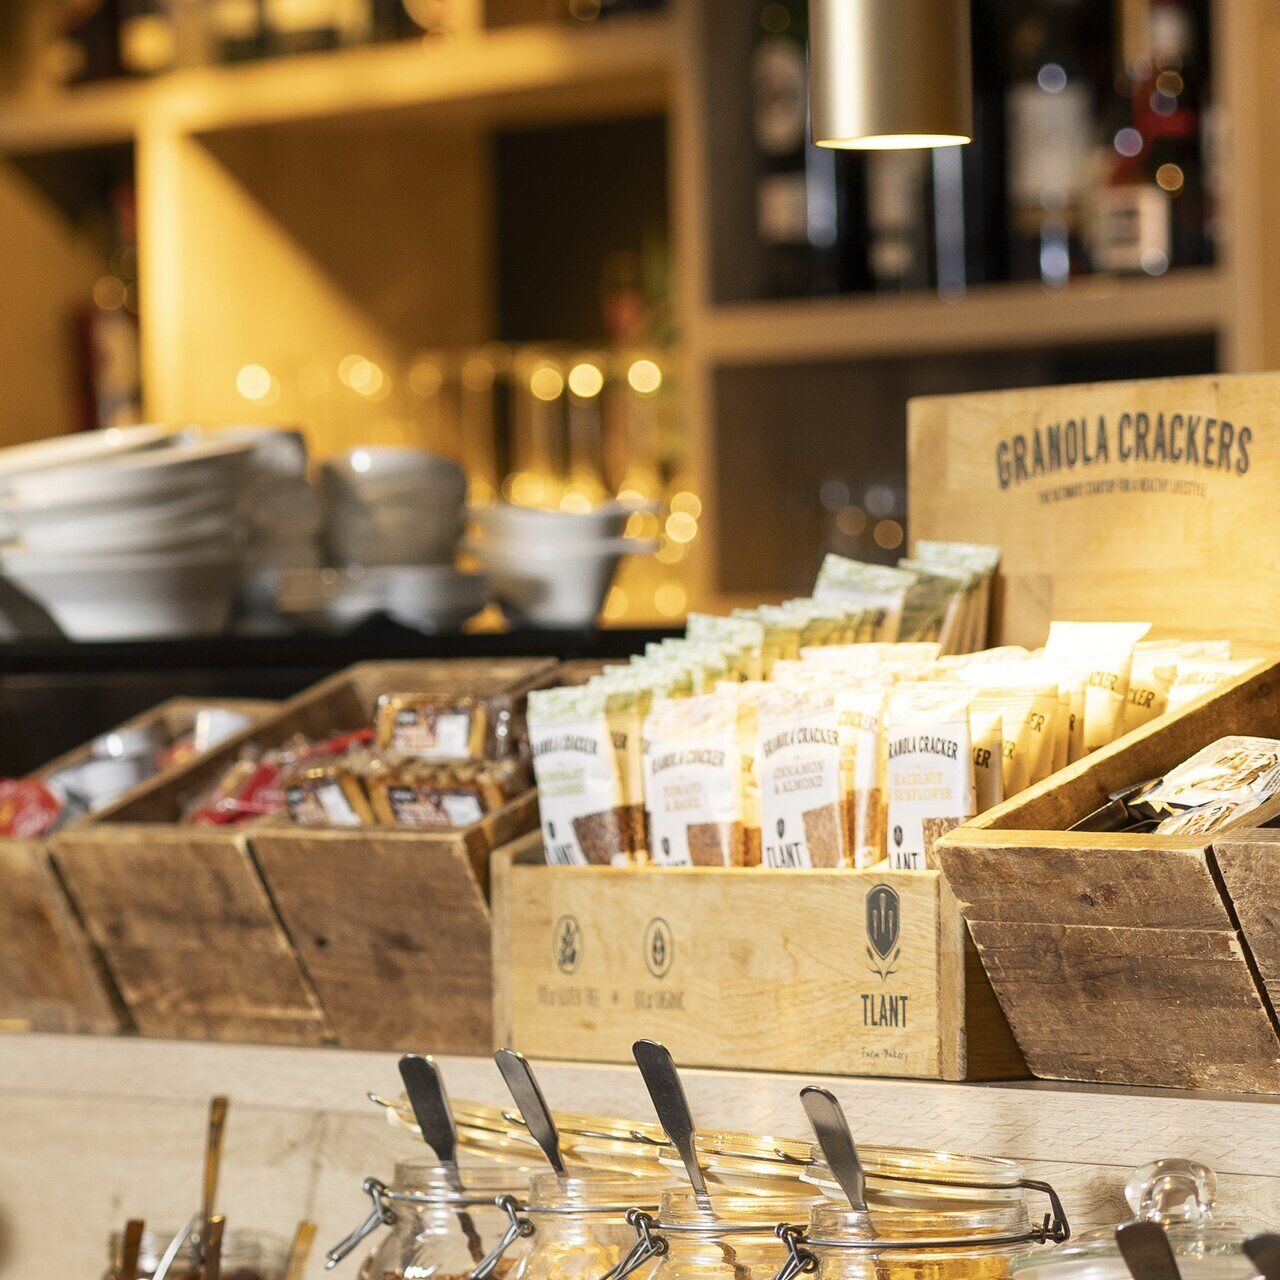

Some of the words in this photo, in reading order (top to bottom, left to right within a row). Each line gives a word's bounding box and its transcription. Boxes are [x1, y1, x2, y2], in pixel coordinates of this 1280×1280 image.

[995, 413, 1109, 492] GRANOLA
[1117, 411, 1252, 476] CRACKERS
[797, 727, 839, 746] CRACKER
[889, 737, 917, 758] RANOLA
[919, 736, 958, 760] CRACKER
[861, 994, 908, 1027] TLANT
